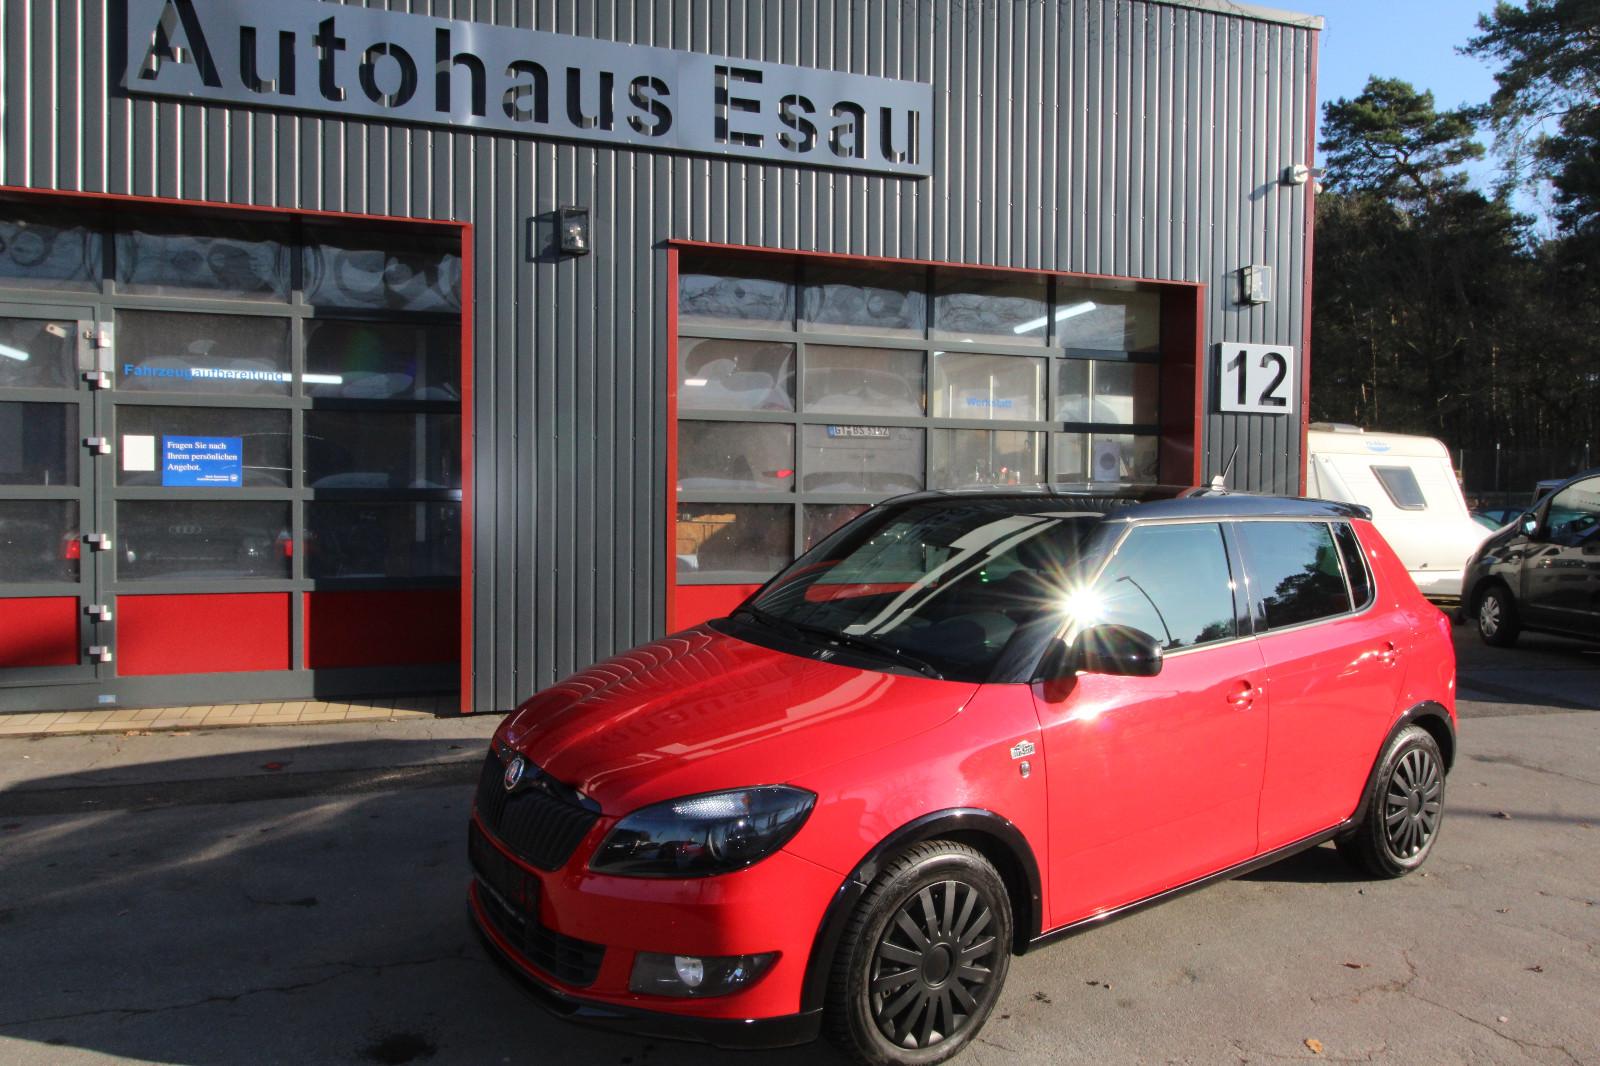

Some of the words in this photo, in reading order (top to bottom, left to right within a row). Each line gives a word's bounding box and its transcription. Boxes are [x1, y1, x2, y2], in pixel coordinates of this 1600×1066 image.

[136, 0, 674, 138] Autohaus
[713, 64, 921, 166] Esau
[1226, 350, 1288, 408] 12
[167, 441, 192, 451] Fragen
[208, 442, 227, 450] nach
[167, 452, 190, 460] Ihrem
[191, 453, 238, 461] persönlichen
[167, 463, 201, 472] Angebot.
